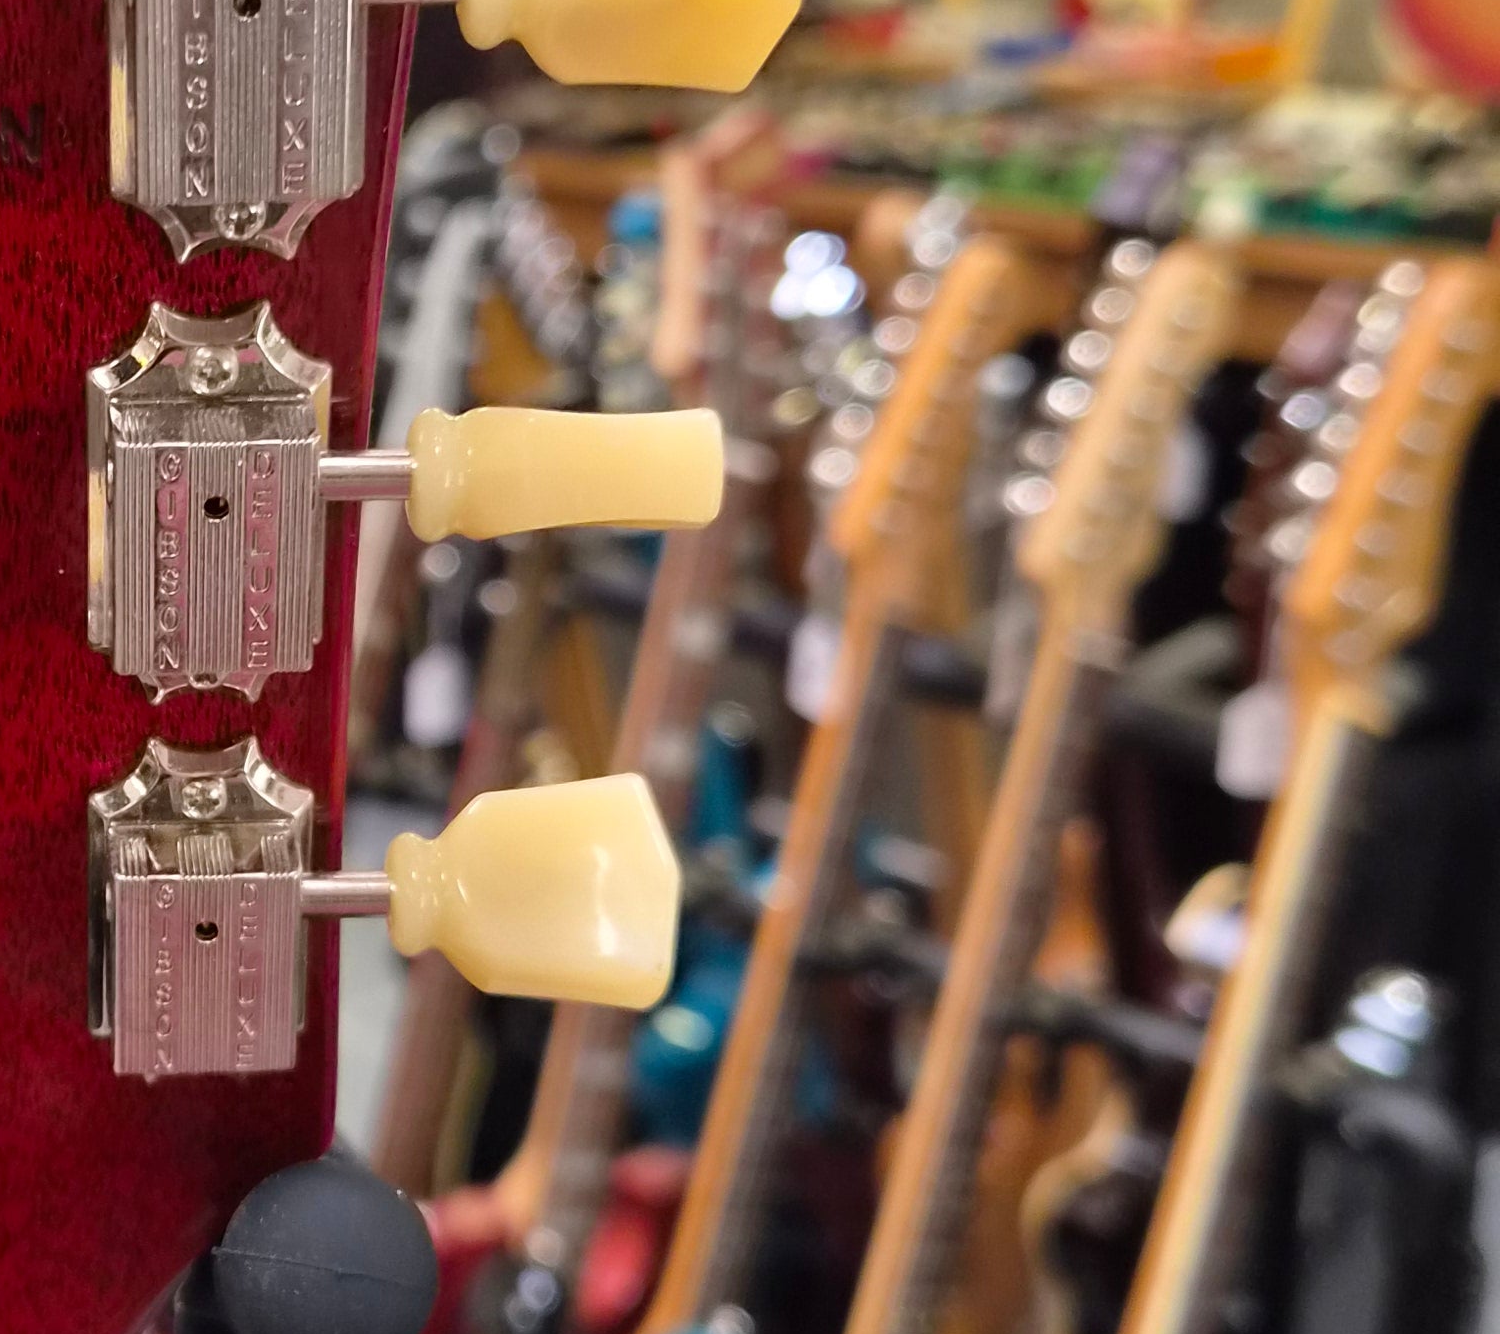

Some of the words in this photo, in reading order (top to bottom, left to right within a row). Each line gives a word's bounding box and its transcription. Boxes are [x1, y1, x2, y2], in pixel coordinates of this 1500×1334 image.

[157, 451, 184, 670] GIBSON
[247, 450, 276, 669] DELUXE
[154, 883, 176, 1069] GIBSON
[235, 881, 260, 1068] DELUXE
